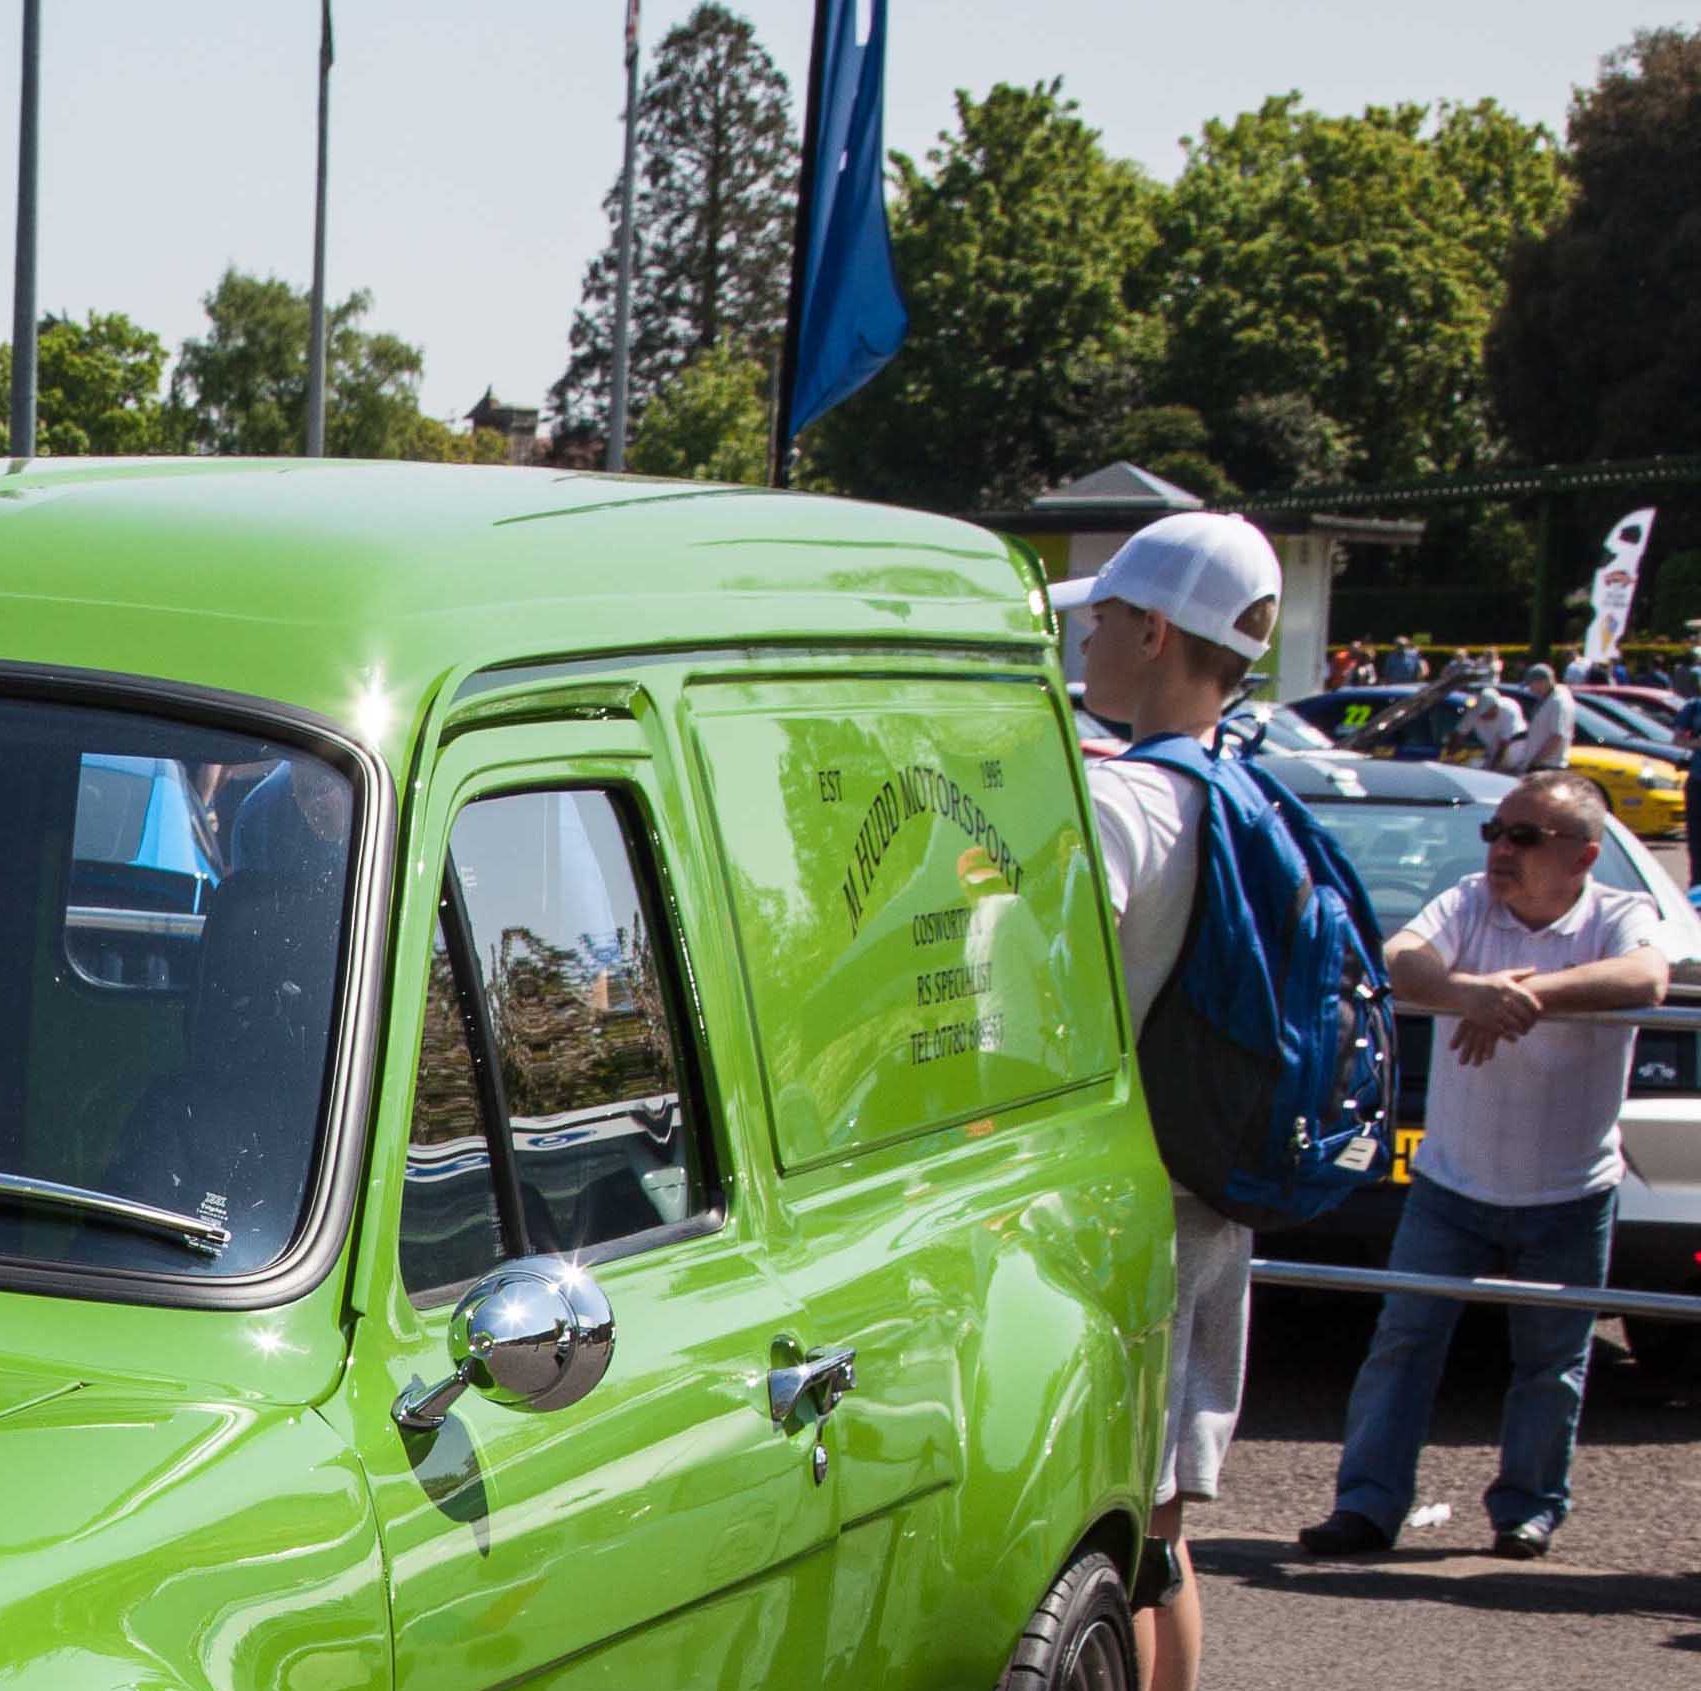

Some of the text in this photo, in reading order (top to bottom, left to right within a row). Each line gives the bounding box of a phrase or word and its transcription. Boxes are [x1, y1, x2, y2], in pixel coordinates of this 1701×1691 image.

[818, 769, 843, 803] EST
[855, 781, 900, 896] HUDD
[898, 765, 1024, 895] MOTORSPORT
[917, 961, 992, 1006] RS SPECIALIST
